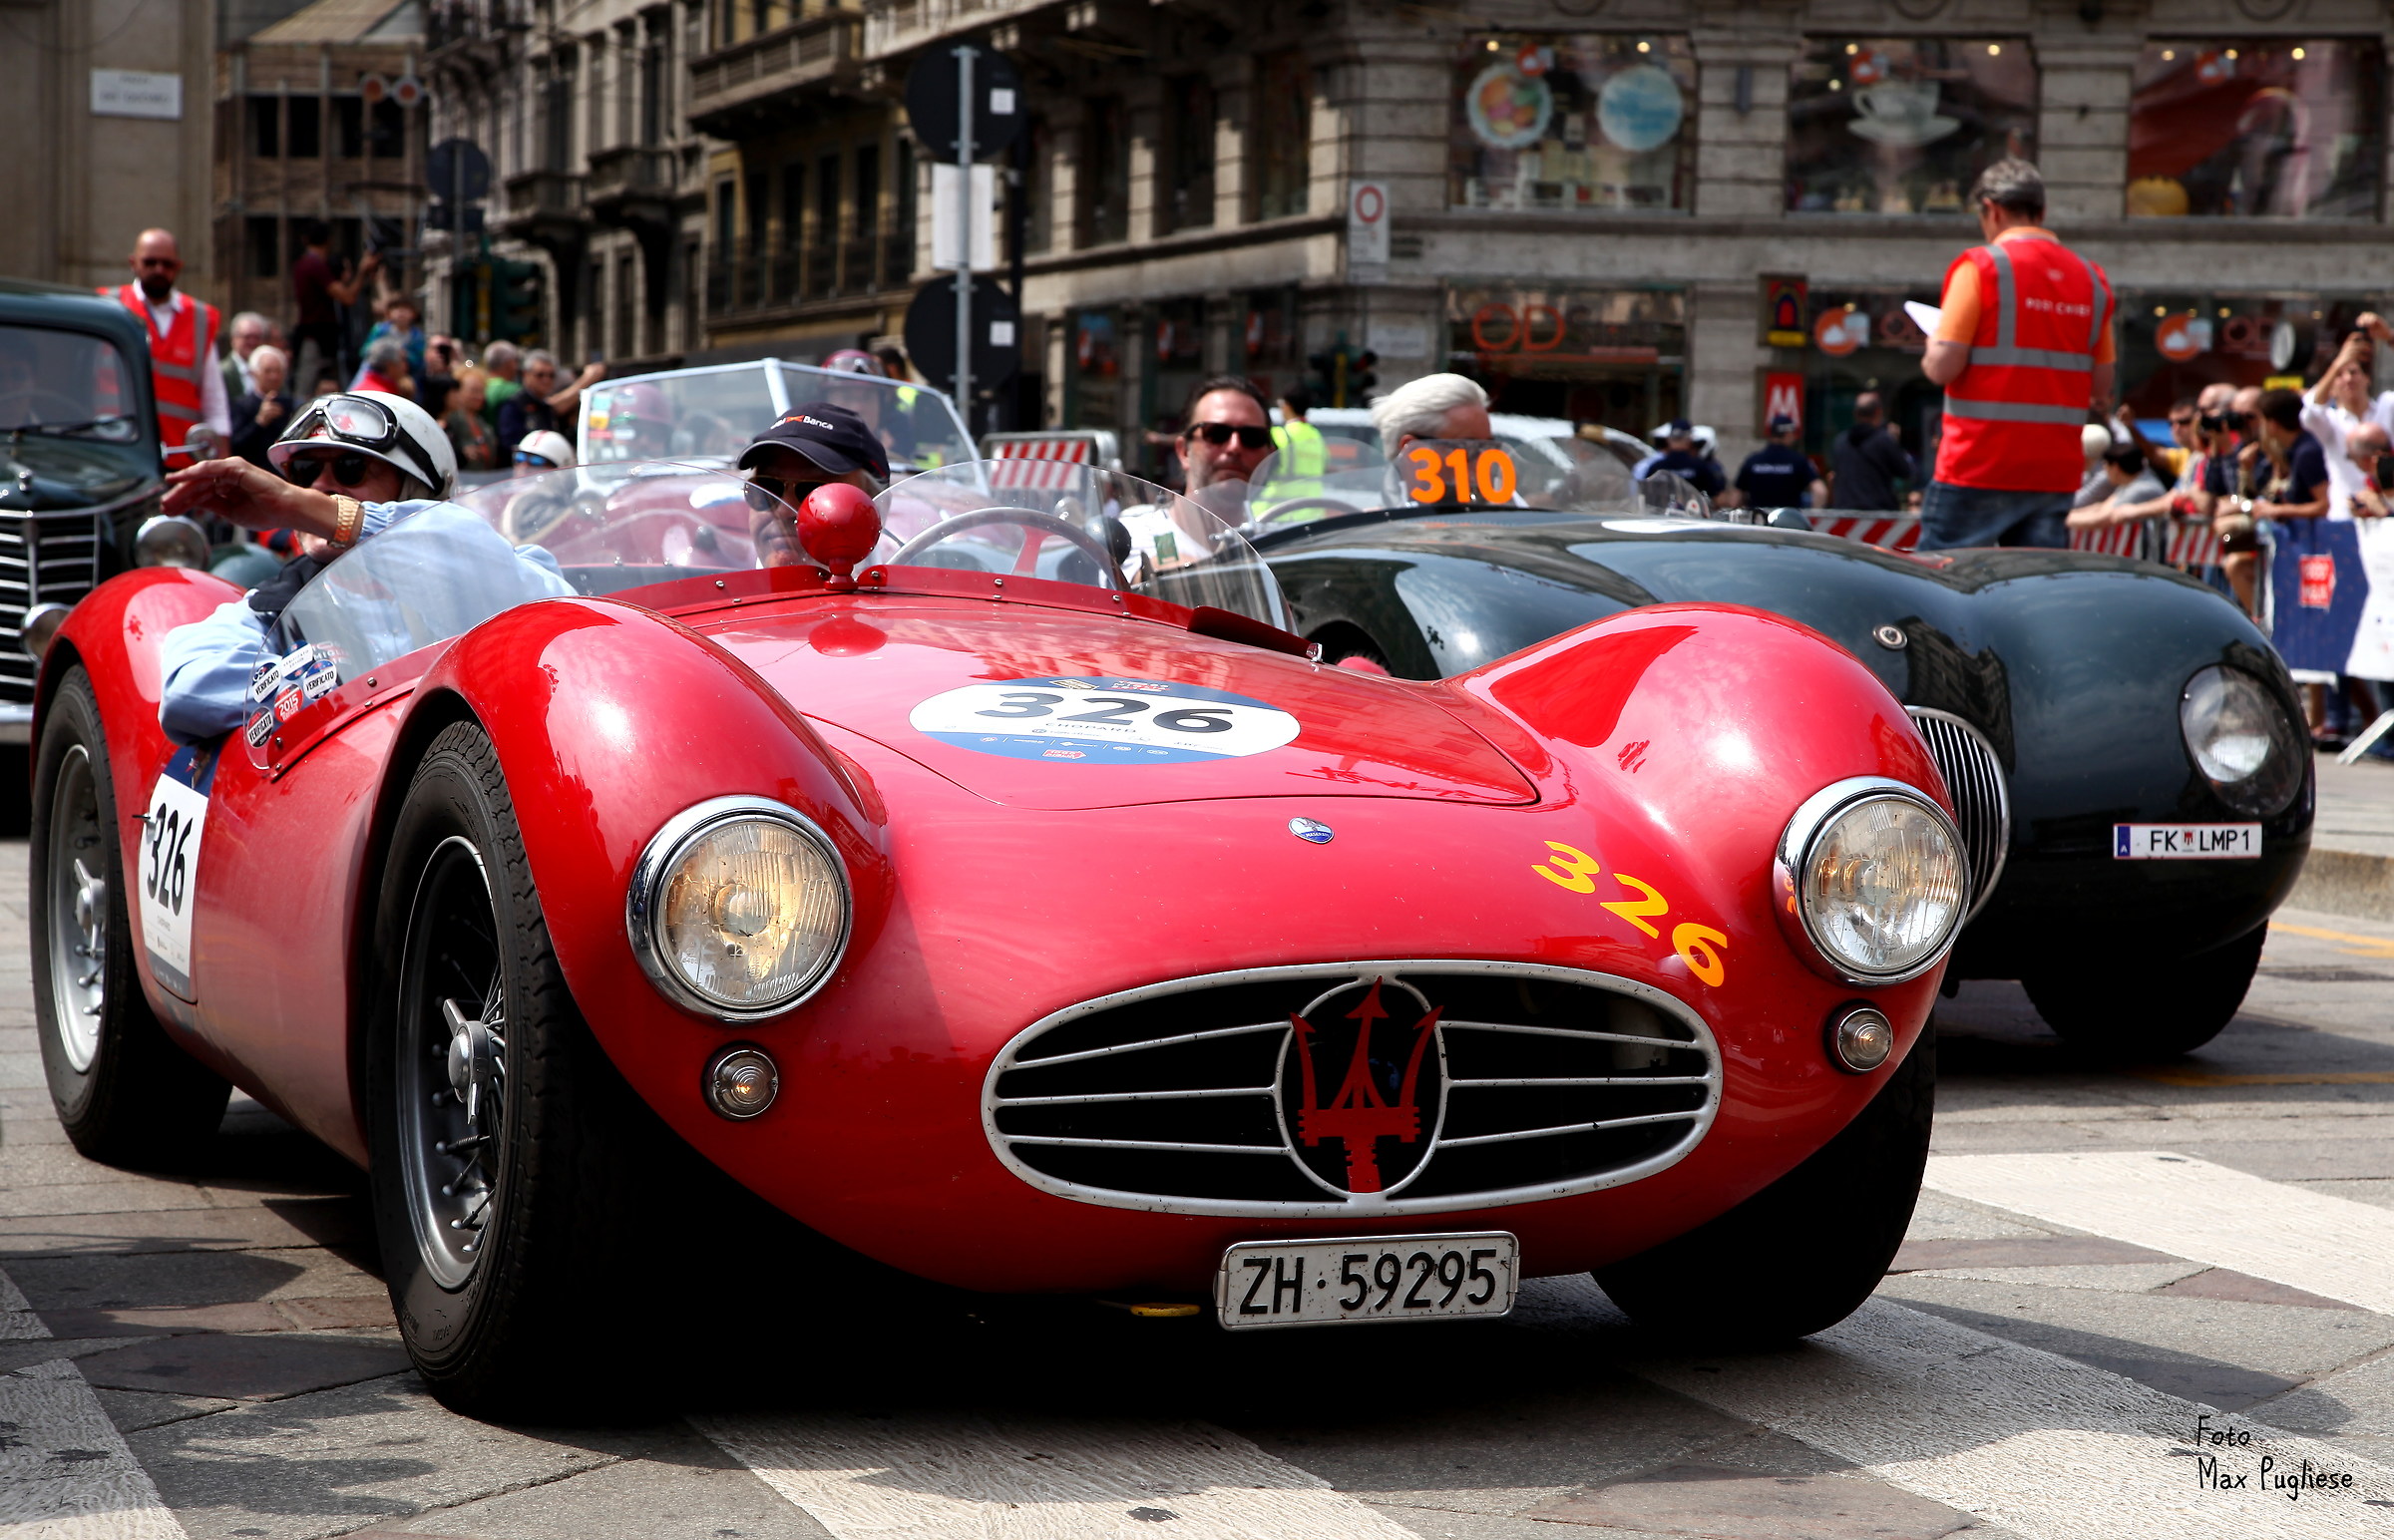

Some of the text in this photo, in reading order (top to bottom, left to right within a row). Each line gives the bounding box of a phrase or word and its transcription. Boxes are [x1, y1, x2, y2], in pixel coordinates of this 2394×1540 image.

[803, 415, 834, 431] Banca
[1407, 447, 1516, 505] 310
[255, 669, 280, 695] VERIFICATO
[305, 670, 334, 691] VERIFICATO
[279, 693, 299, 716] 2015
[974, 692, 1234, 734] 326
[248, 714, 272, 742] VERIFICATO
[2120, 845, 2129, 854] A
[2150, 830, 2179, 852] FK
[146, 802, 194, 917] 326
[1530, 840, 1729, 988] 326
[1339, 1249, 1497, 1313] 59295
